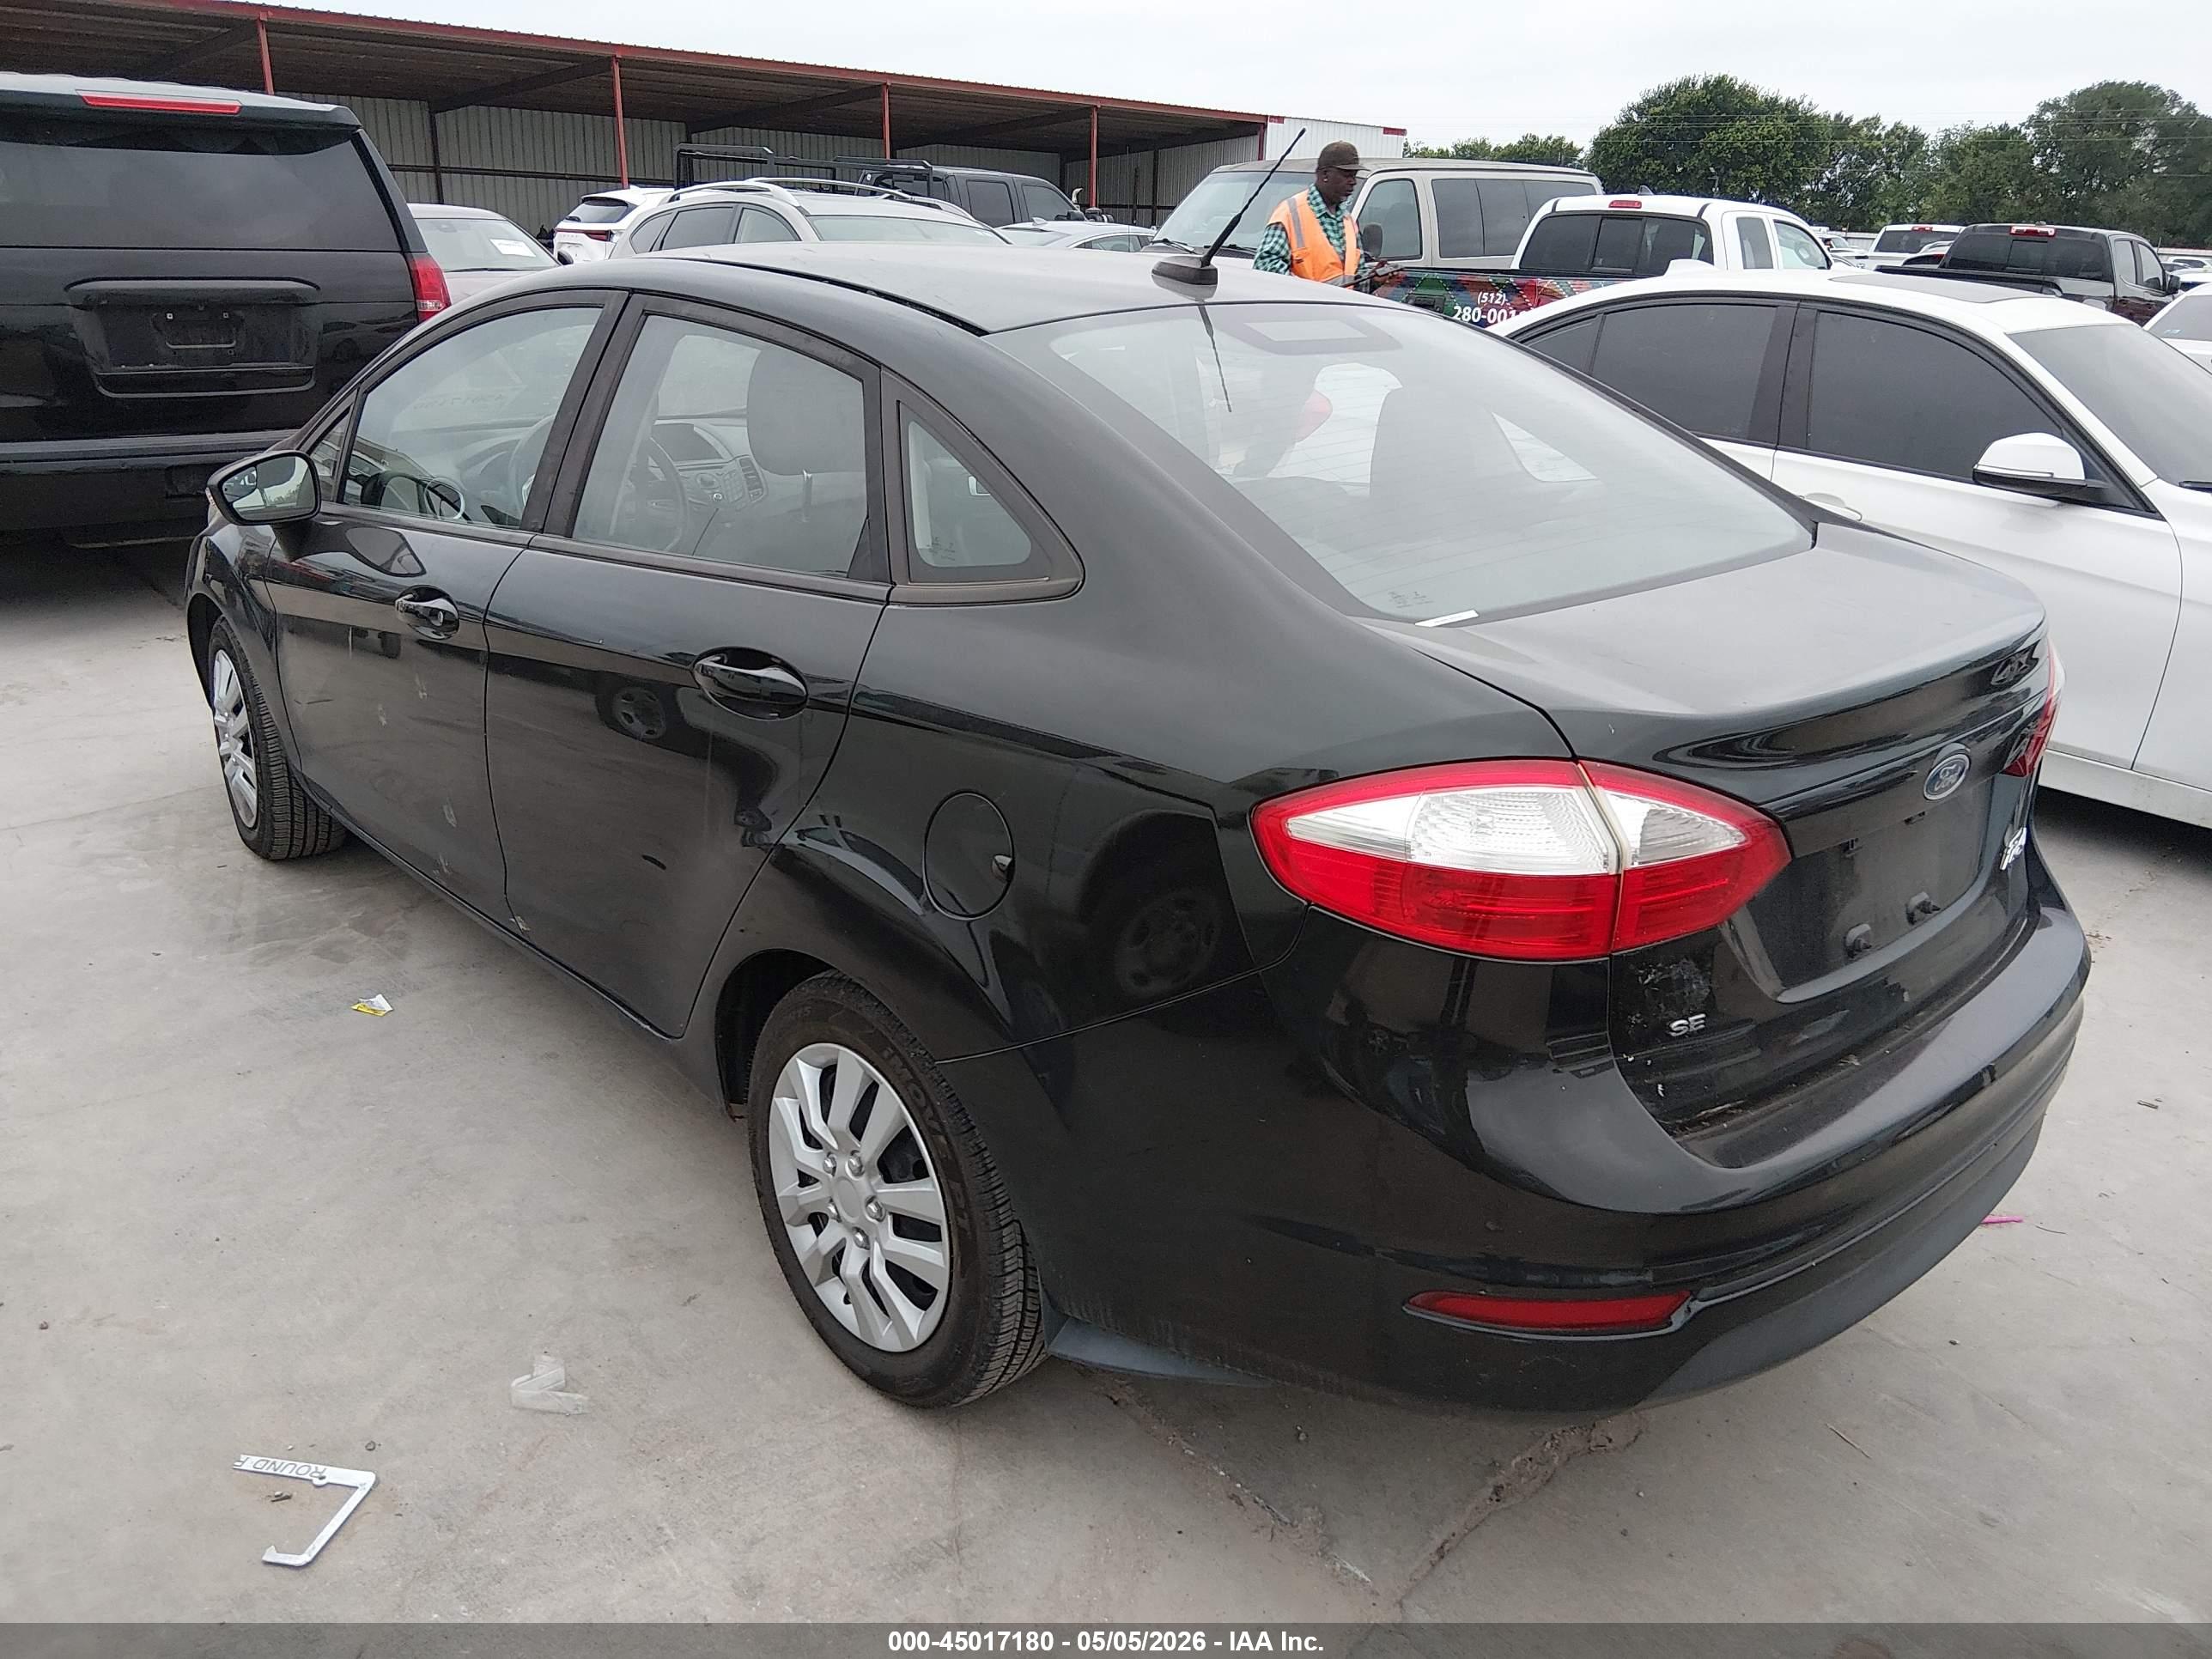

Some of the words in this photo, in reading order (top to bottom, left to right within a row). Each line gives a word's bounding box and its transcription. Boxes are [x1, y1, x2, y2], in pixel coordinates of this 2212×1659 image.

[1478, 292, 1505, 306] (512)
[1668, 1013, 1706, 1037] SE
[252, 1458, 327, 1480] ROUND
